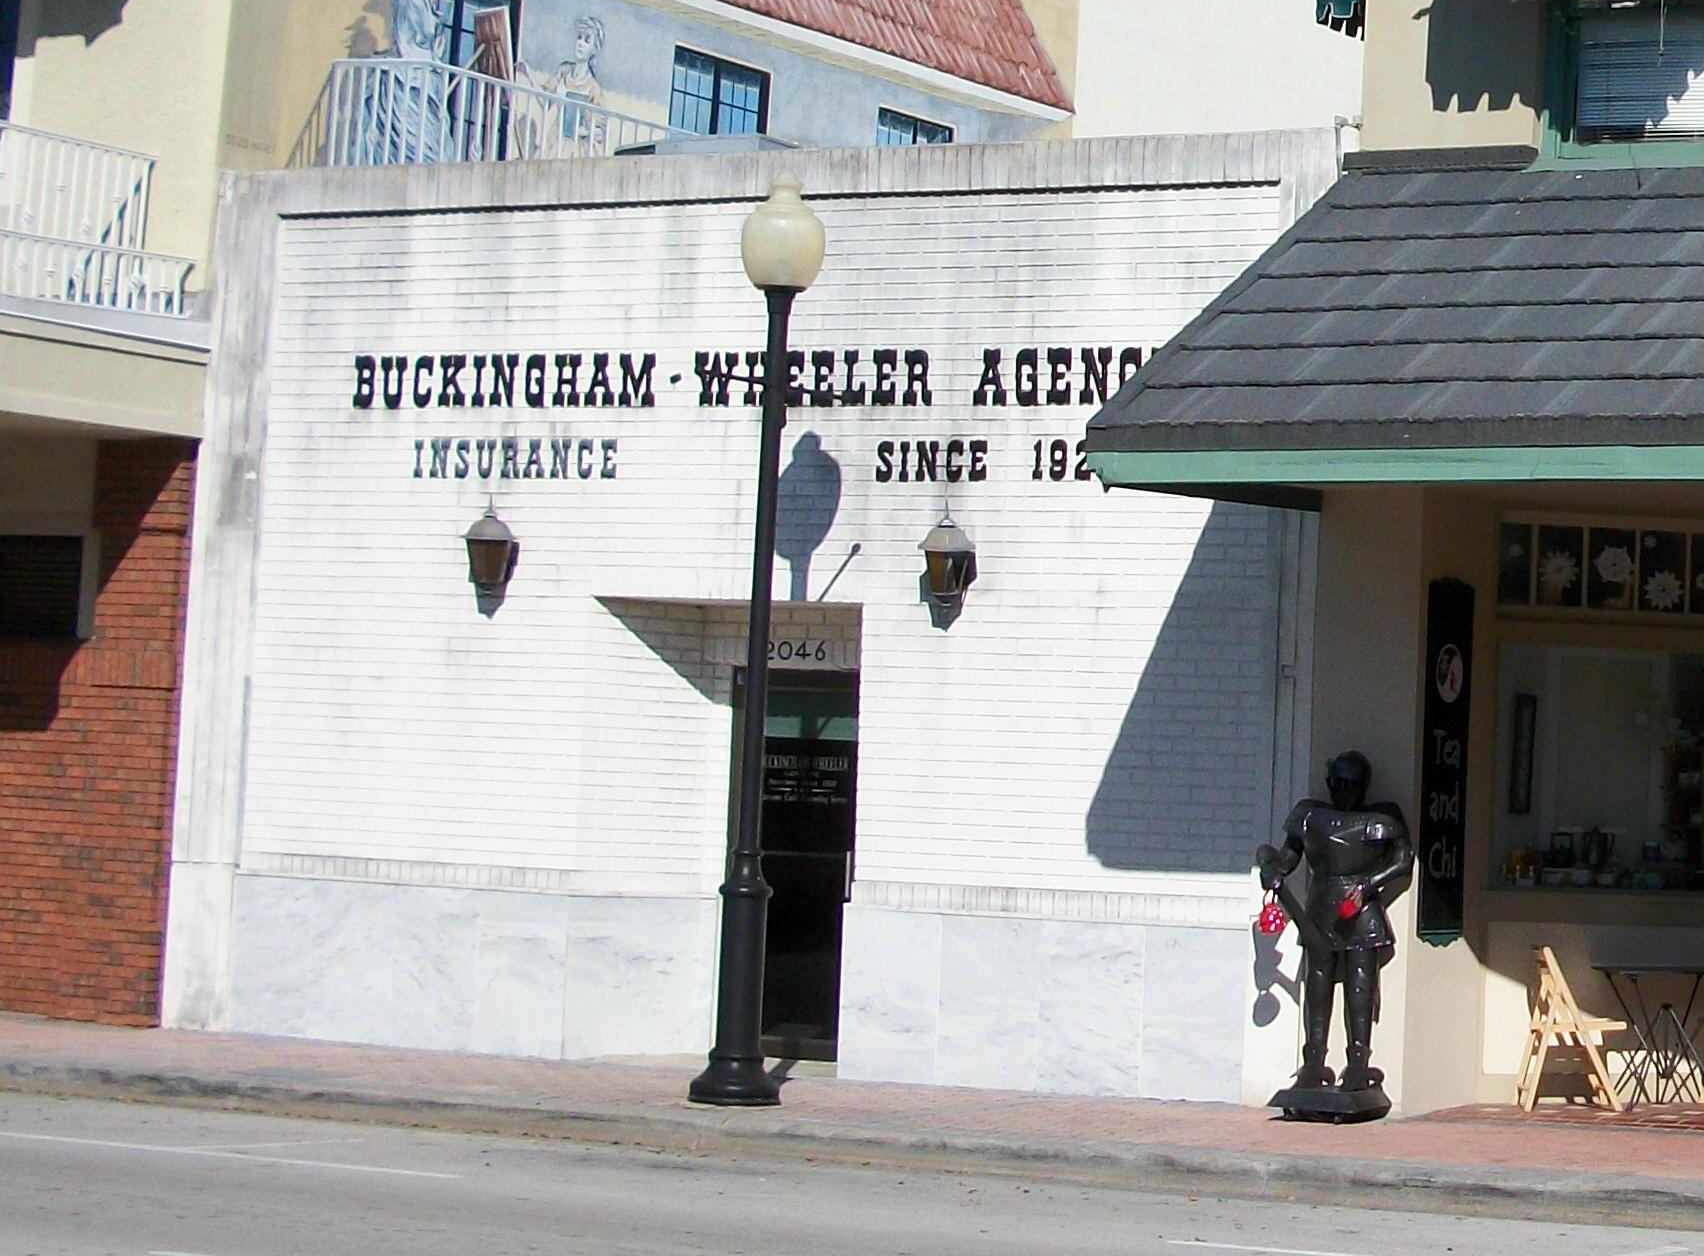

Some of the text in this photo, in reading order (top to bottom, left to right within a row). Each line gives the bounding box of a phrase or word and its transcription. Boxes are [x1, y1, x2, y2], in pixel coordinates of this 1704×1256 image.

[352, 352, 656, 409] BUCKINGHAM
[695, 350, 932, 407] WHEELER
[973, 347, 1160, 406] AGENC
[413, 439, 618, 479] INSURANCE
[876, 439, 1097, 482] SINCE 192
[767, 640, 826, 661] 2046
[1433, 728, 1461, 768] Tea
[1429, 781, 1460, 824] and
[1429, 836, 1457, 879] Chi
